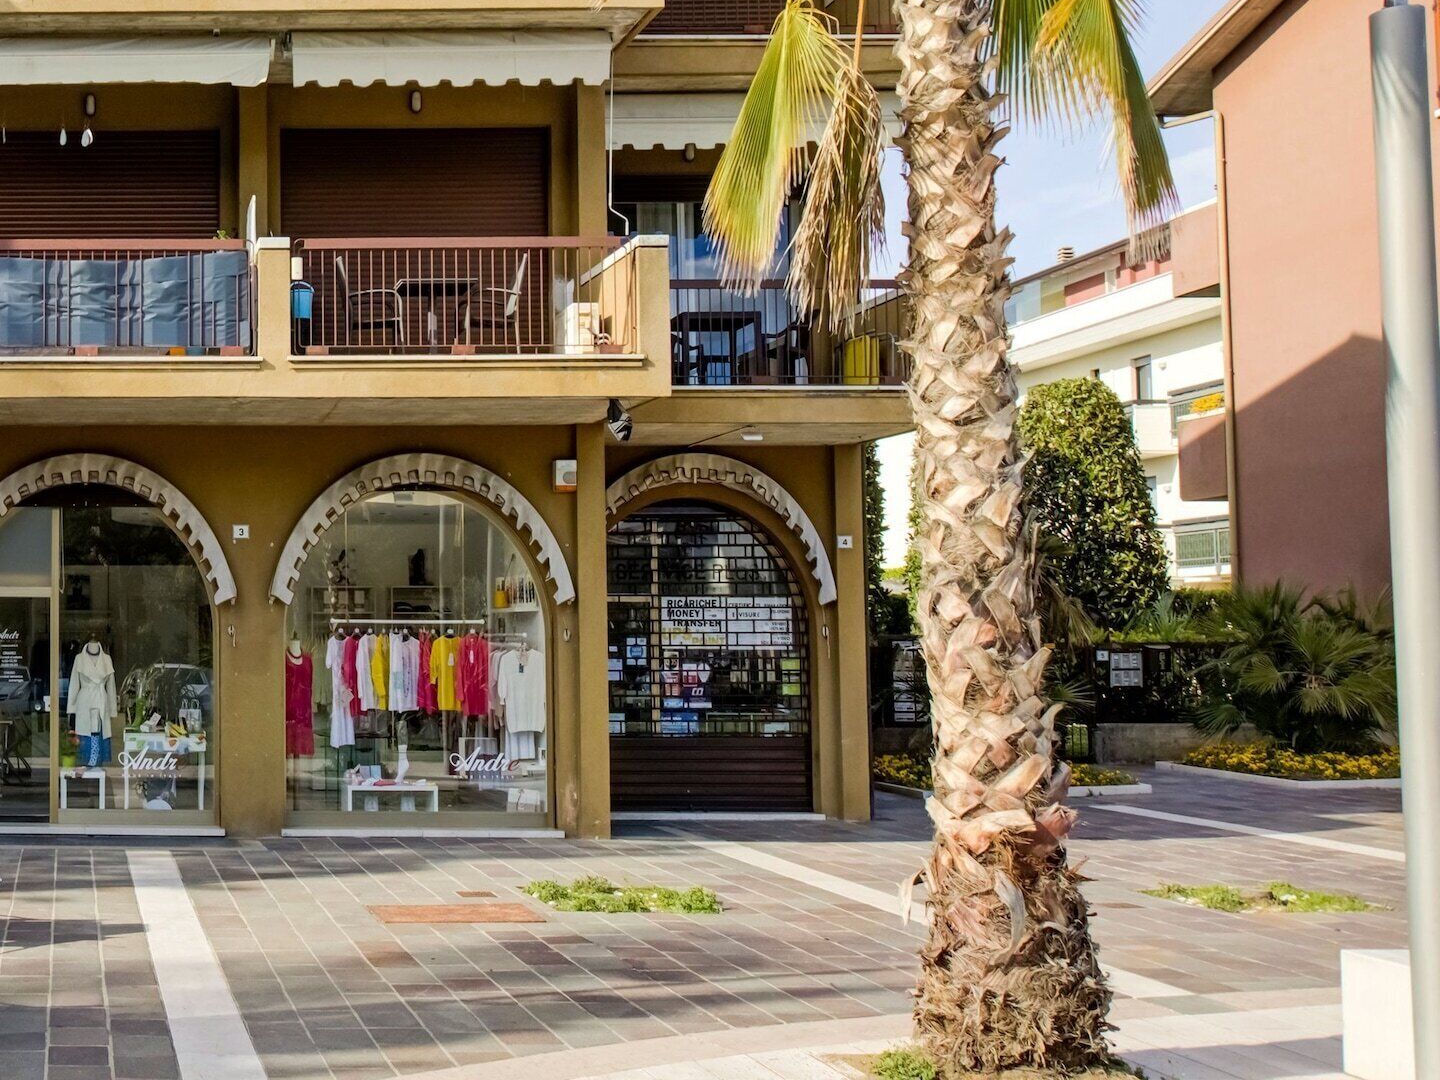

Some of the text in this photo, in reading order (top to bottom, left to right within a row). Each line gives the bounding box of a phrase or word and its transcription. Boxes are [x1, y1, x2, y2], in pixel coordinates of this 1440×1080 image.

[238, 527, 244, 537] 3
[842, 538, 848, 546] 4
[667, 599, 717, 608] RICARICHE
[667, 609, 701, 618] MONEY
[673, 619, 721, 627] TRANSFER
[118, 745, 182, 771] Andr
